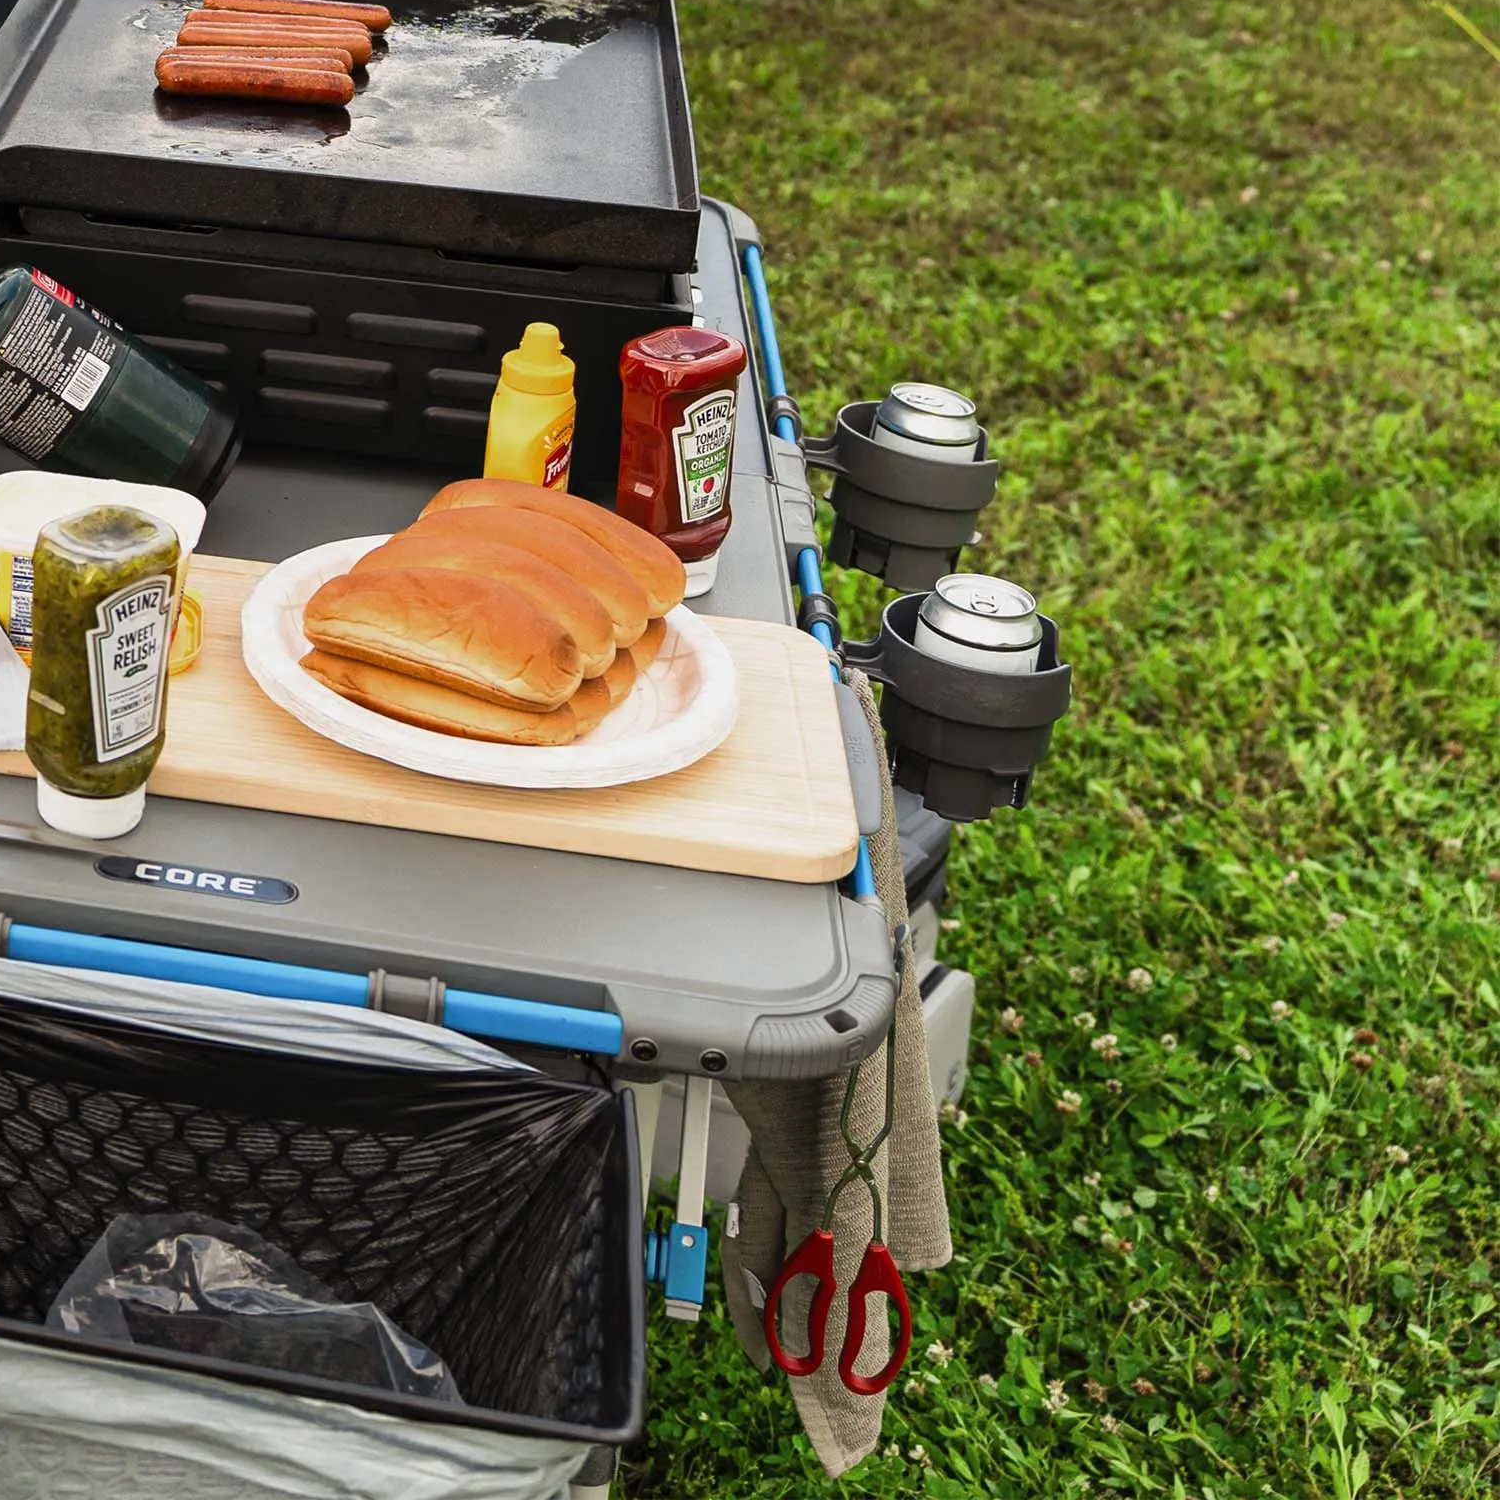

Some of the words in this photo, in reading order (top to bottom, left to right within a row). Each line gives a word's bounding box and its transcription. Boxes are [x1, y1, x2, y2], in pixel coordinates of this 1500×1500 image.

[696, 404, 728, 427] HEINZ
[695, 424, 727, 447] TOMATO
[691, 450, 726, 471] ORGANIC
[115, 591, 160, 623] HEINZ
[117, 621, 156, 651] SWEET
[113, 638, 157, 672] RELISH
[135, 862, 258, 896] CORE
